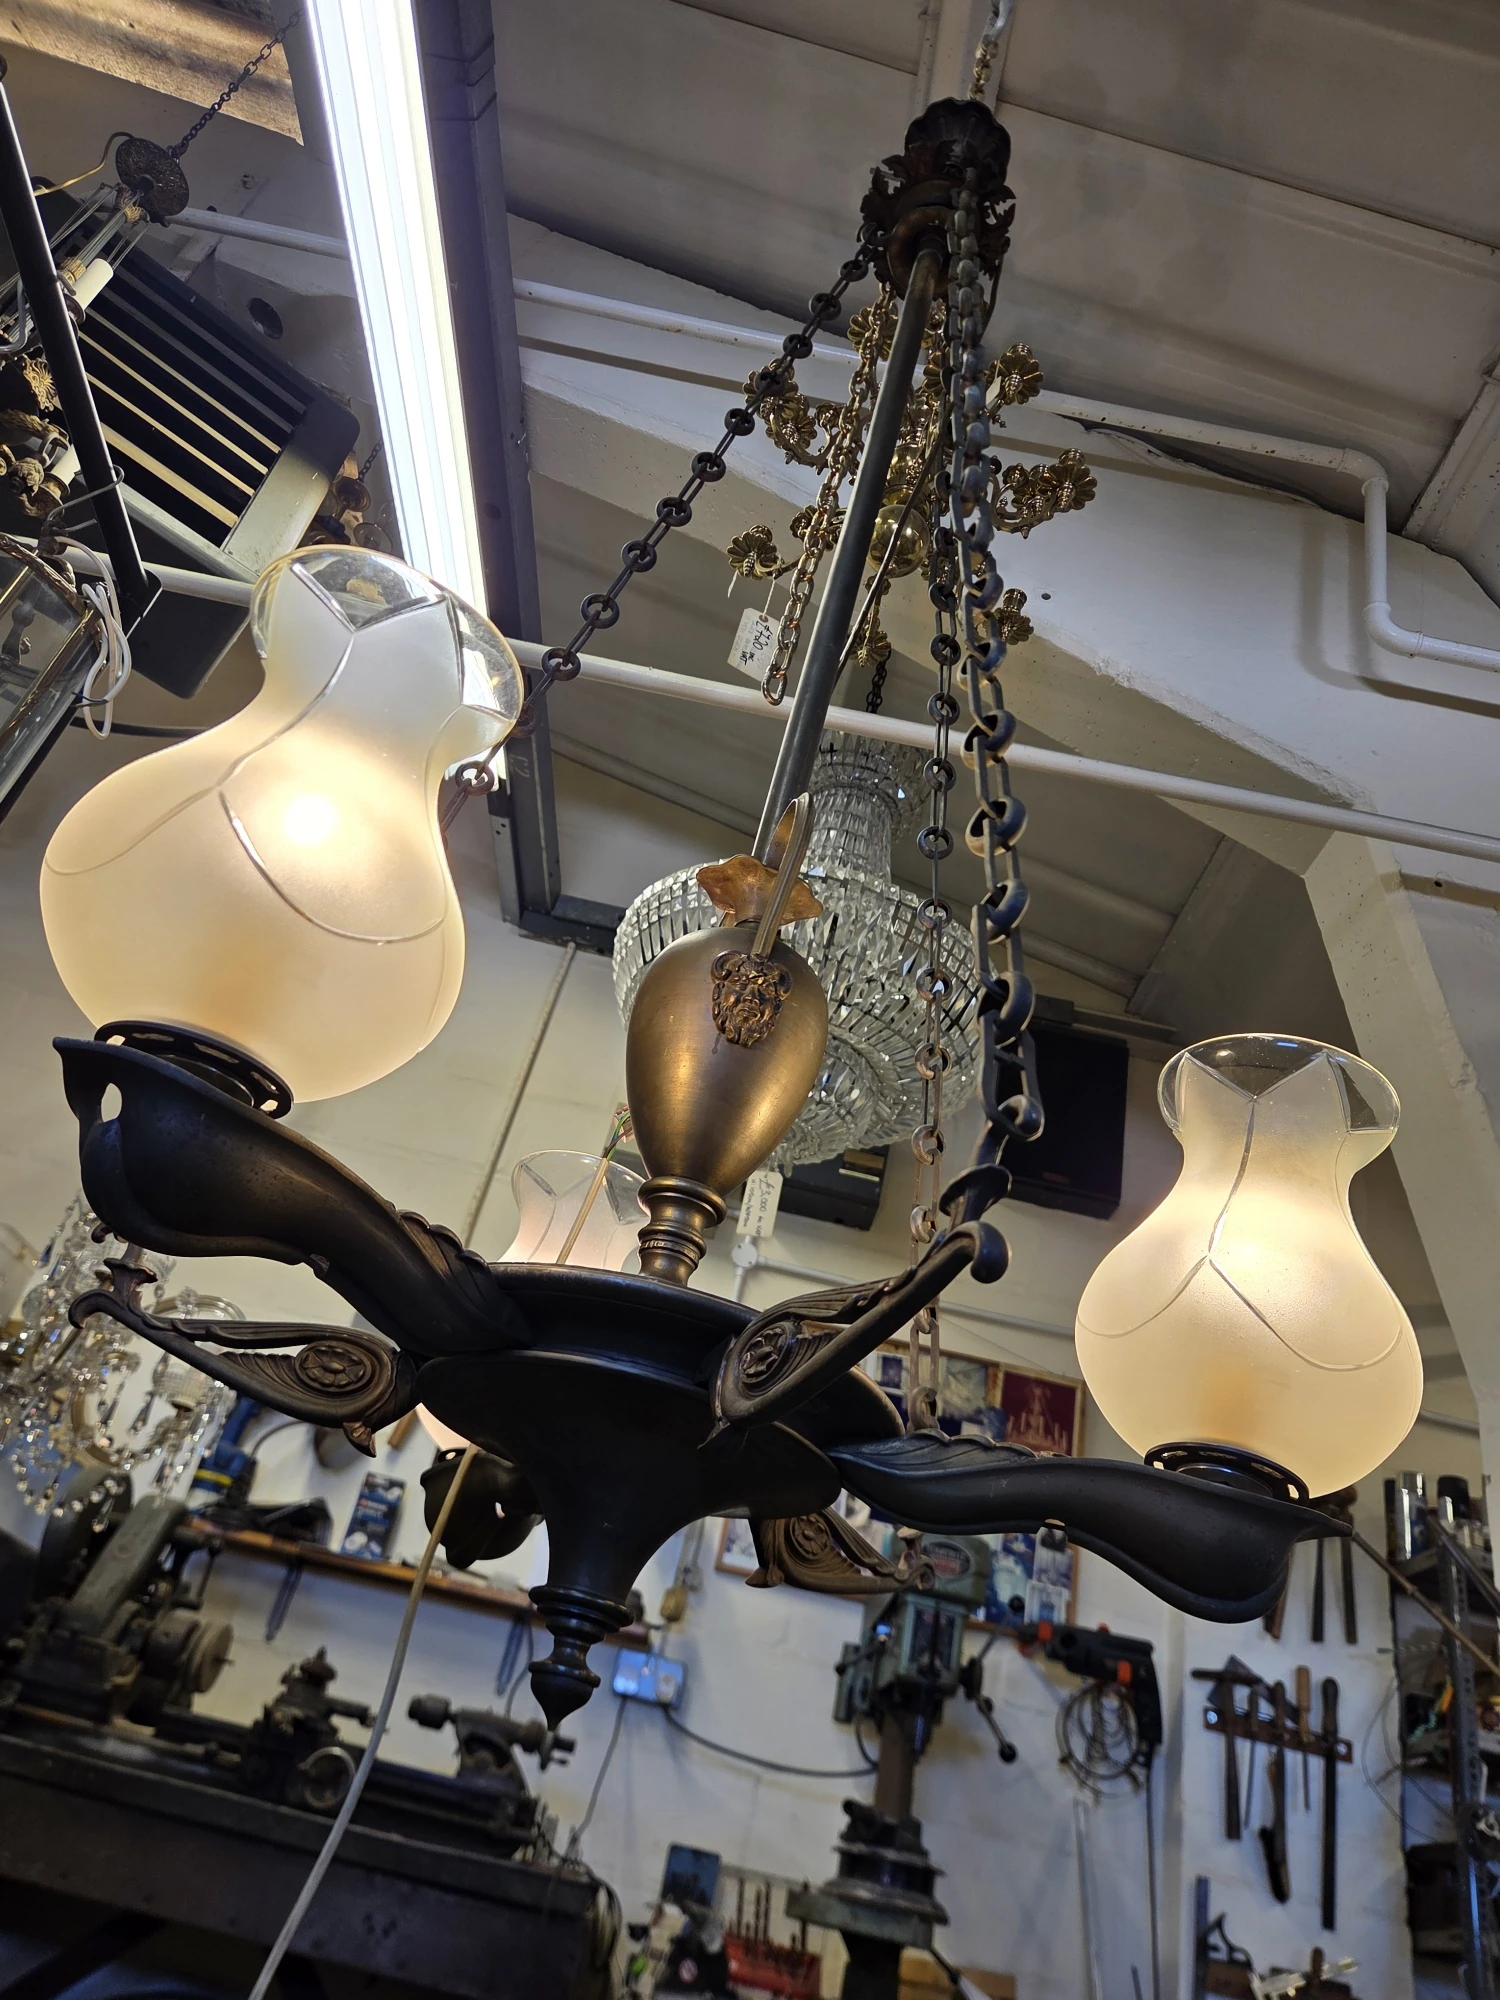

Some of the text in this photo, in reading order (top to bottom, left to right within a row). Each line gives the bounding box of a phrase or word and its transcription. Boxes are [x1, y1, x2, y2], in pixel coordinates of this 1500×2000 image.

[752, 620, 773, 651] £720
[740, 650, 749, 666] VAT
[759, 1177, 775, 1212] £3,000
